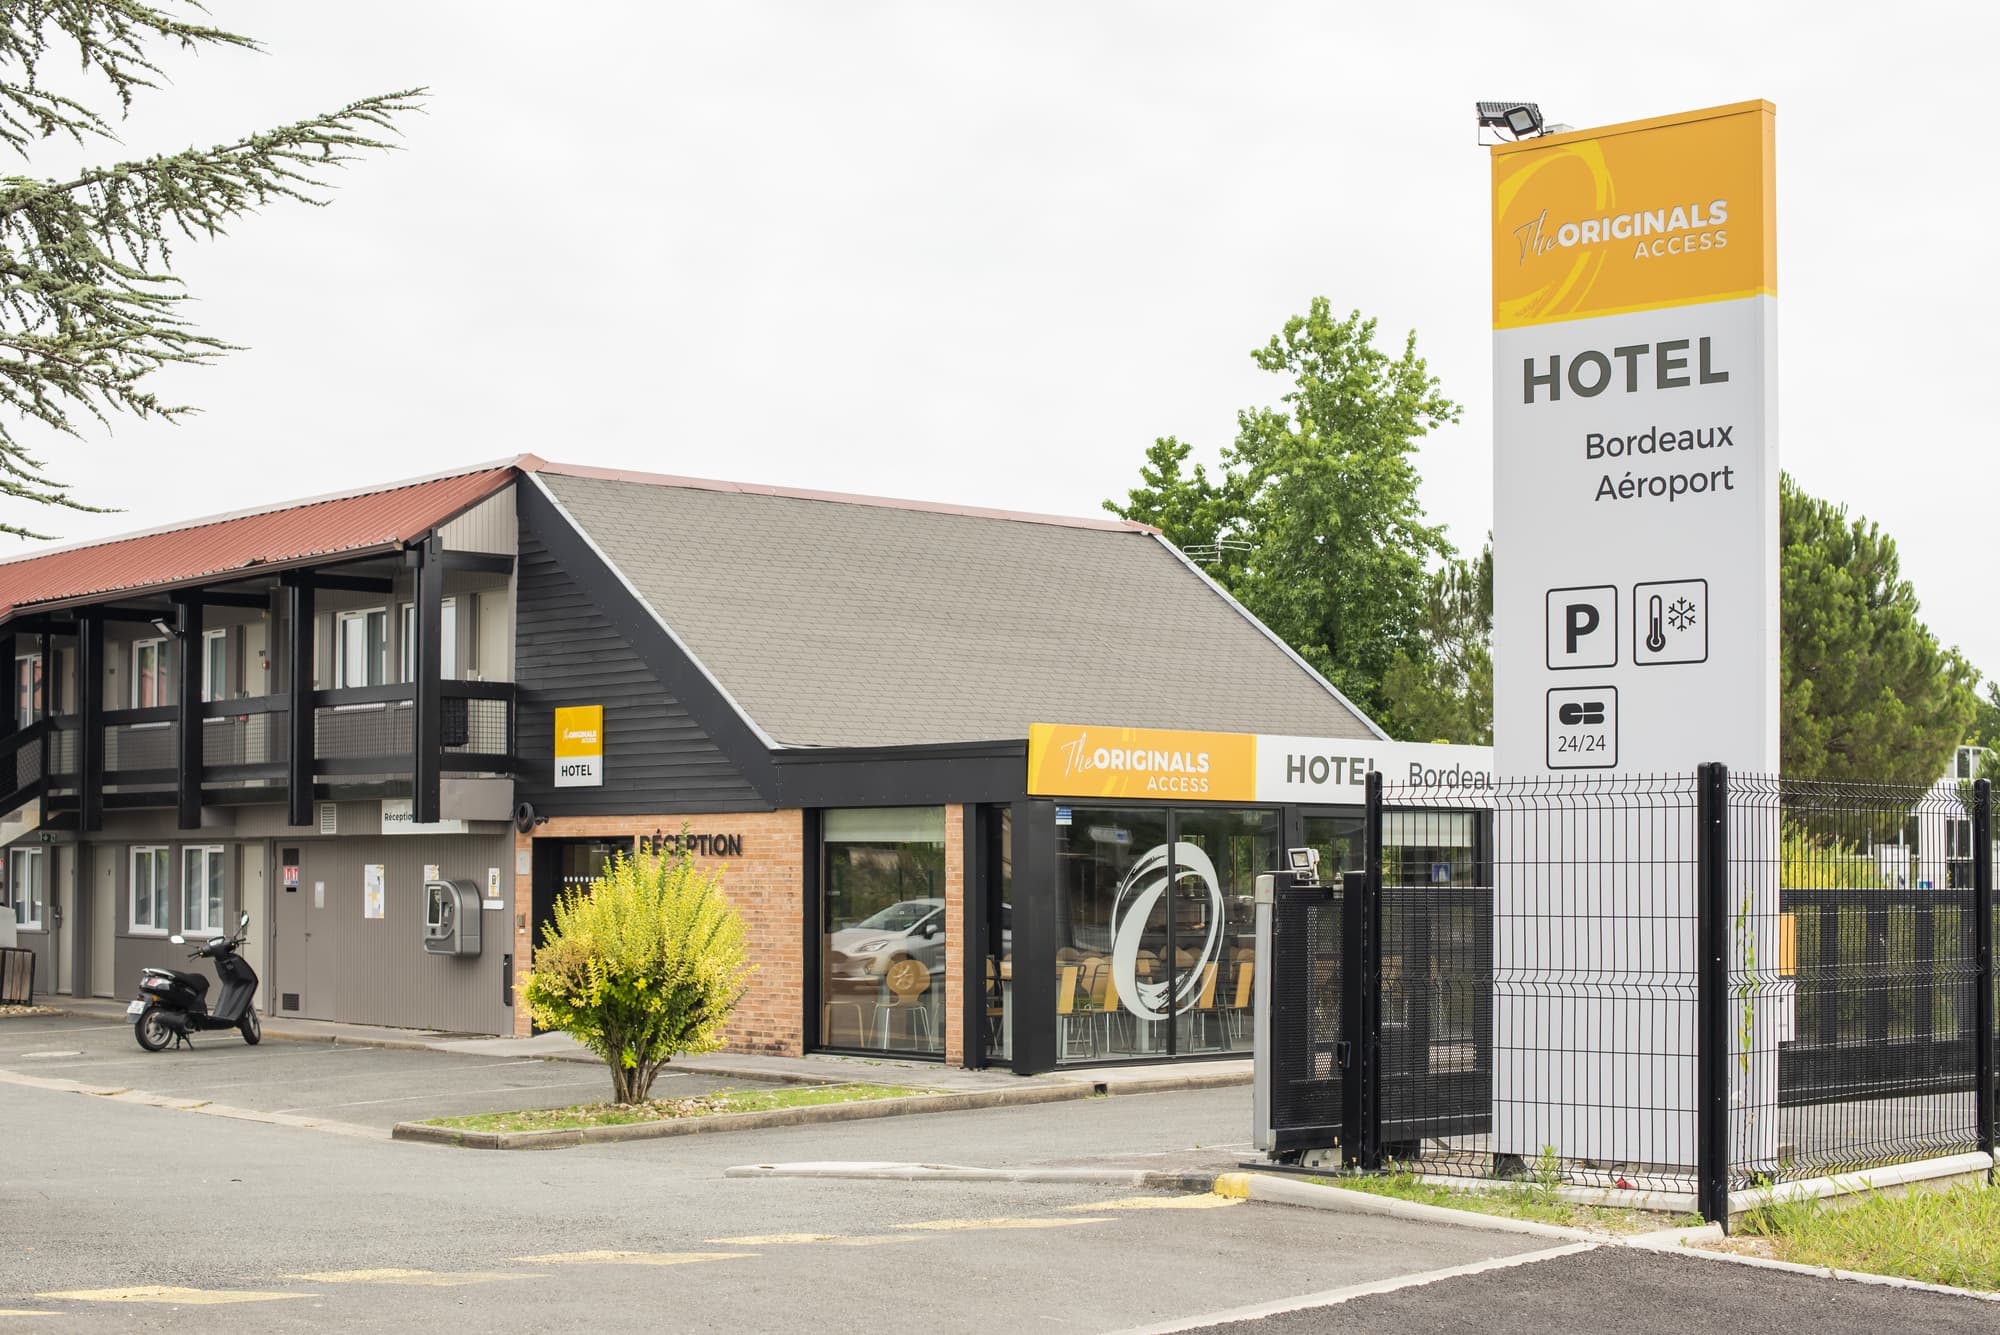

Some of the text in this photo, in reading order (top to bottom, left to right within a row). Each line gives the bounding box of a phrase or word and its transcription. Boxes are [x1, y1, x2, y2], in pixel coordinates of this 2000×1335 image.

[1557, 200, 1728, 247] ORIGINALS
[1633, 230, 1728, 259] ACCESS
[1523, 336, 1729, 404] HOTEL
[1586, 425, 1734, 460] Bordeaux
[1595, 465, 1734, 501] Aéroport
[1566, 603, 1600, 653] P
[1061, 731, 1209, 777] The ORIGINALS
[1558, 734, 1606, 752] 24/24
[561, 763, 592, 777] HOTEL
[1147, 776, 1208, 792] ACCESS
[384, 812, 415, 823] Réceptio
